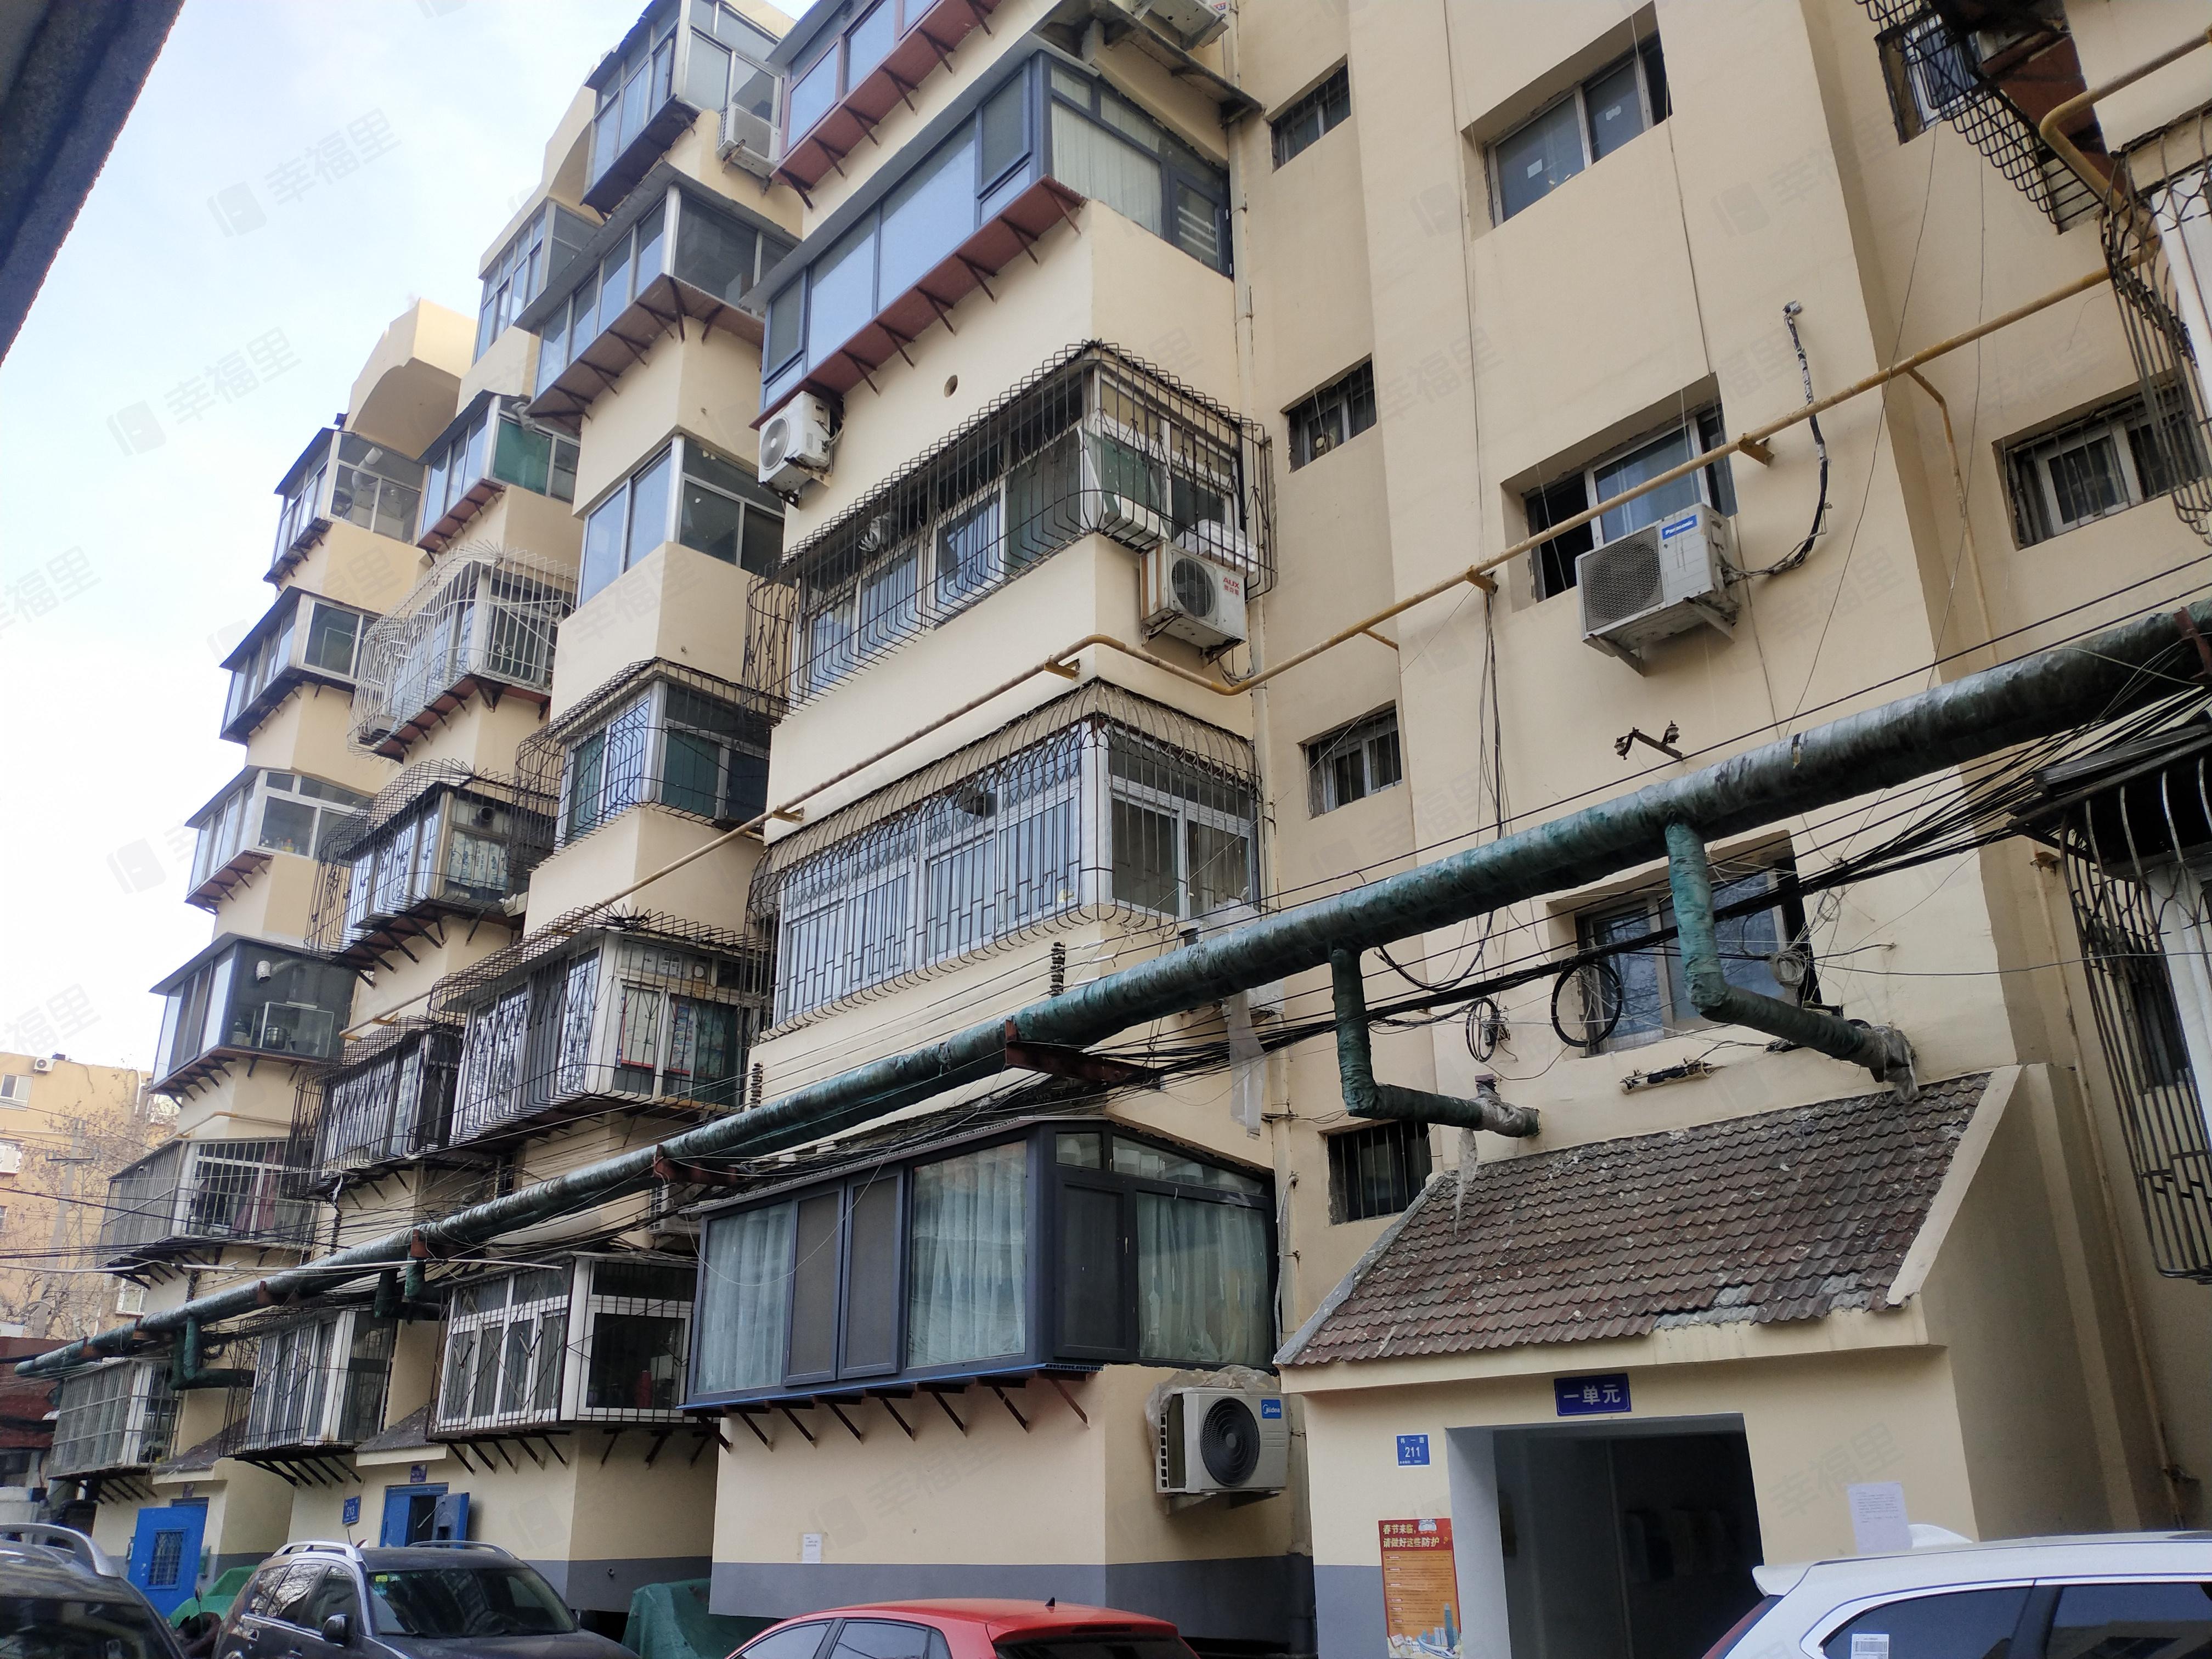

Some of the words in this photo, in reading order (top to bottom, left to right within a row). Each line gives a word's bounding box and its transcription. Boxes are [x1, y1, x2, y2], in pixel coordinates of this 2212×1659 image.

[1223, 577, 1239, 589] AUX
[1564, 1384, 1621, 1405] 一单元
[1263, 1404, 1280, 1414] Midea
[1405, 1447, 1420, 1457] 211
[1384, 1537, 1440, 1548] 请做好这些防护
